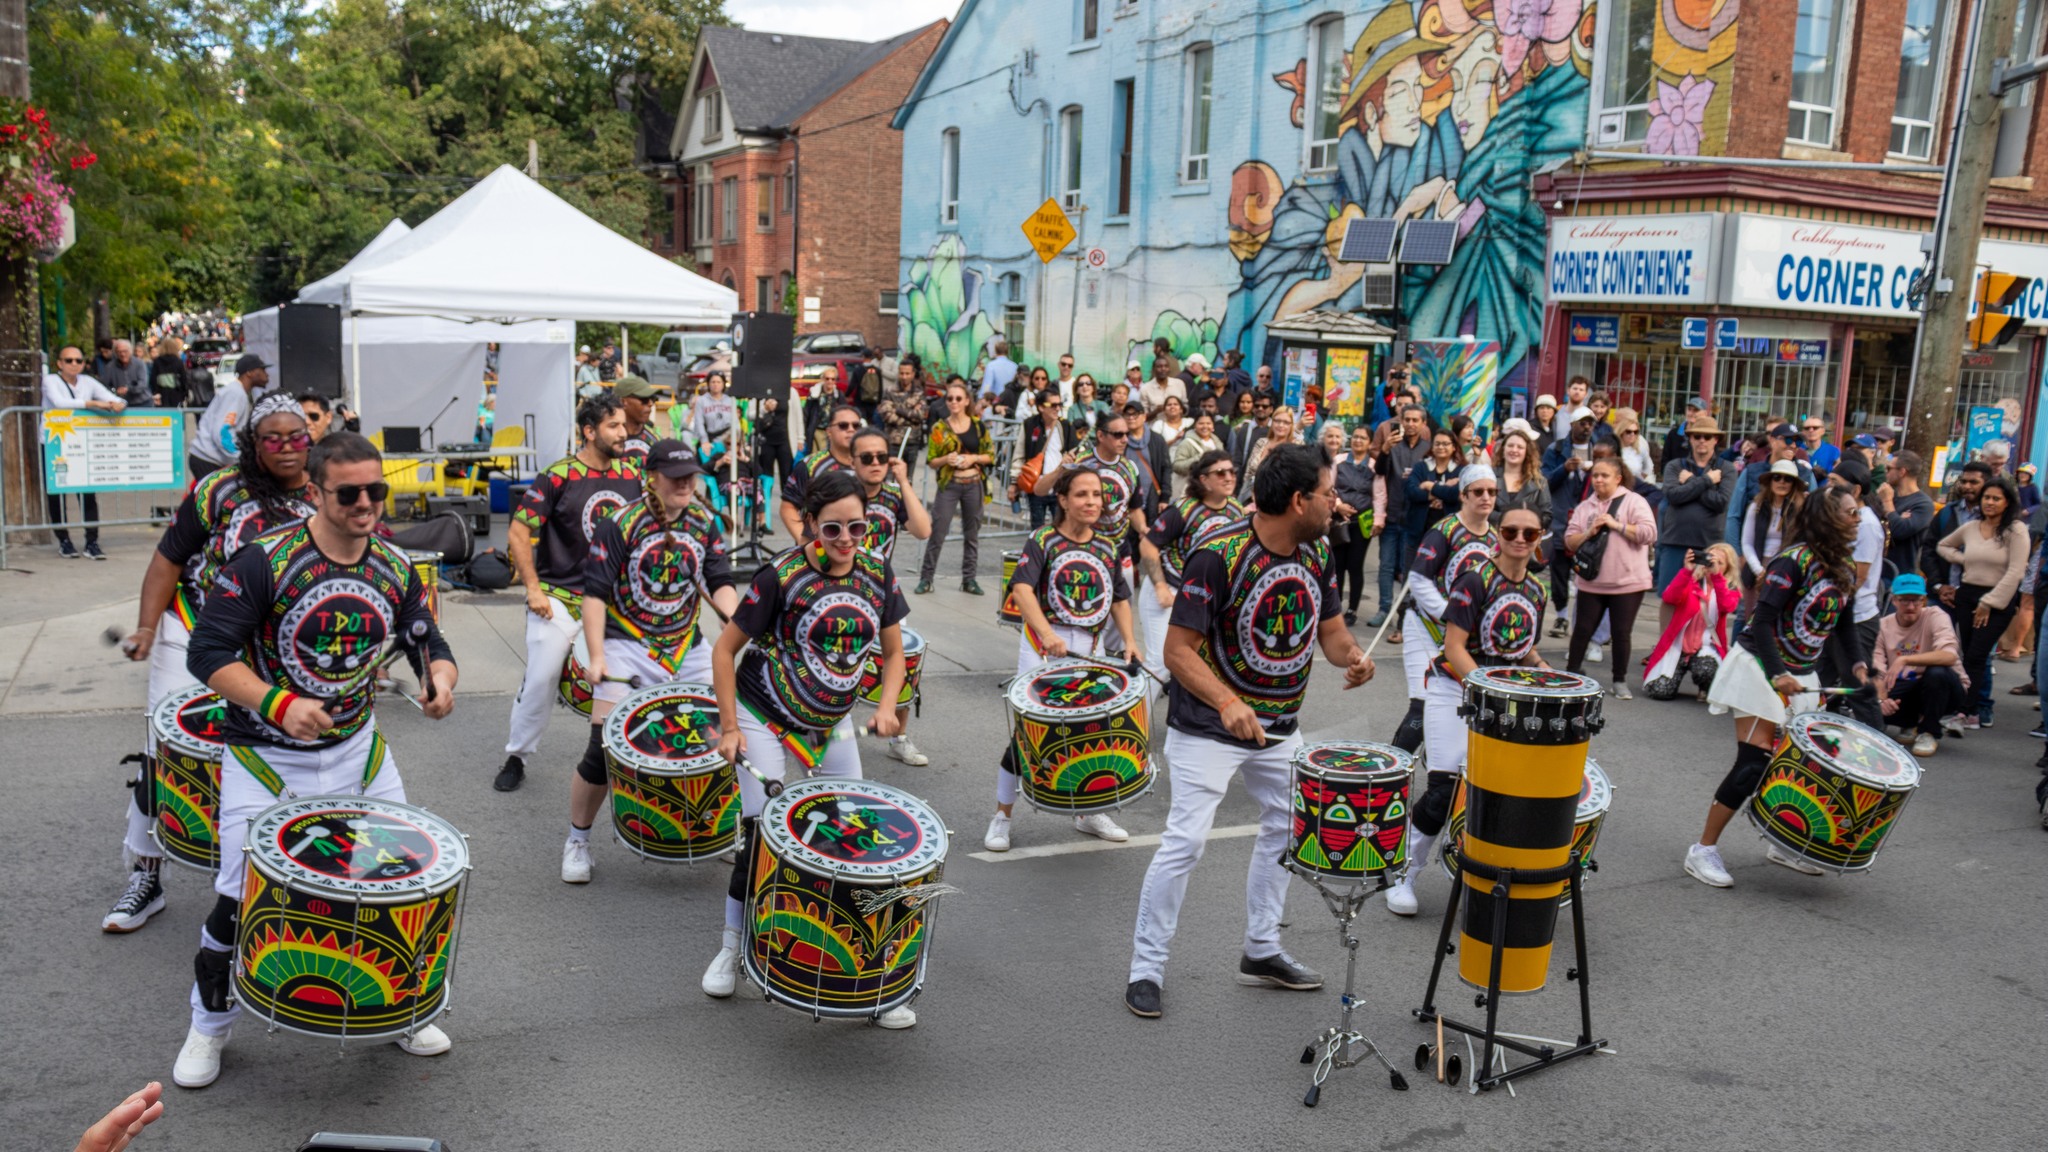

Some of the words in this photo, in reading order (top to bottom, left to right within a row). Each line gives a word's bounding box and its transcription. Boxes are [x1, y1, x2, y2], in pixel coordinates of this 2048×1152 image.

[1036, 212, 1065, 227] TRAFFIC
[1034, 226, 1064, 240] CALMING
[1570, 220, 1679, 248] Cabbagetown
[1792, 225, 1886, 256] Cabbagetown
[1552, 251, 1599, 294] CORNER
[1602, 249, 1693, 295] CONVENIENCE
[1776, 253, 1884, 307] CORNER
[1689, 329, 1706, 337] Phone
[1720, 329, 1737, 337] Phone
[1736, 337, 1770, 354] ATM
[1800, 344, 1821, 353] Centre
[1266, 612, 1306, 636] BATU
[822, 636, 864, 653] BATU
[816, 795, 847, 804] SAMBA
[324, 812, 363, 820] SAMBA
[793, 799, 818, 820] REGGAE
[289, 814, 323, 834] REGGAE
